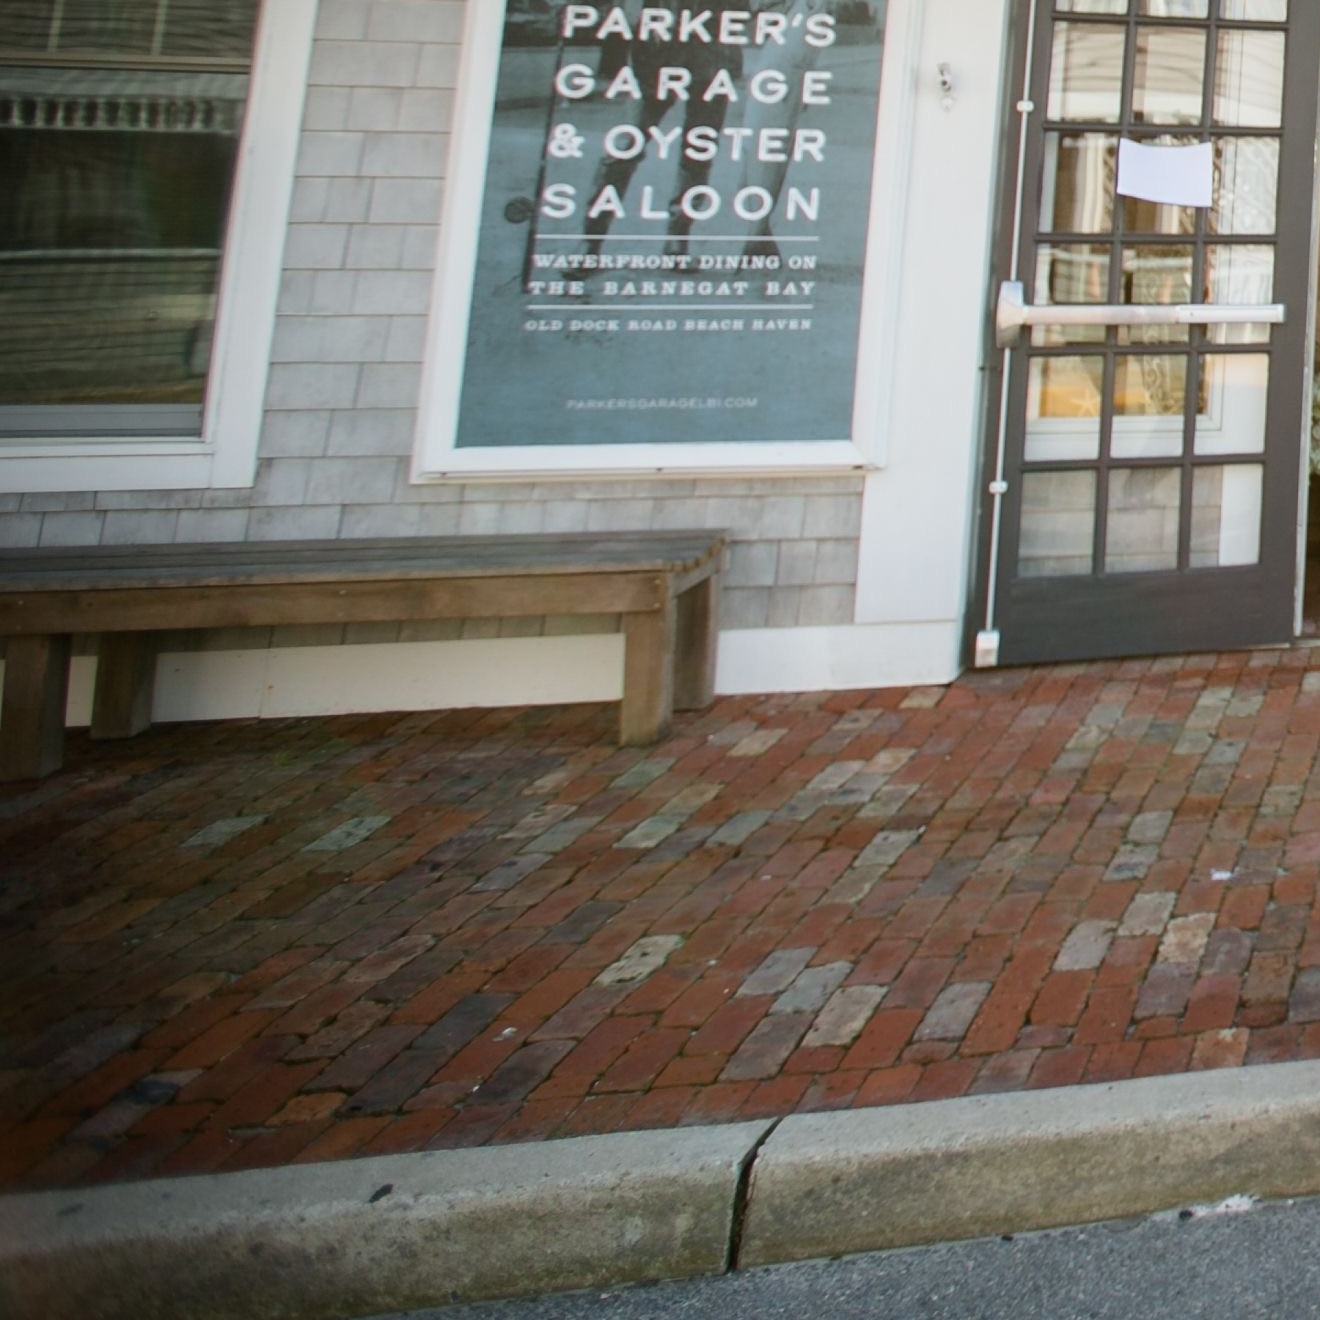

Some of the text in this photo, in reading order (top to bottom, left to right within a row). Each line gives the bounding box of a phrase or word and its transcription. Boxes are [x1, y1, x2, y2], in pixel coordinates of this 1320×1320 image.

[562, 4, 837, 48] PARKER'S
[554, 63, 834, 105] GARAGE
[548, 123, 827, 163] & OYSTER
[541, 183, 821, 222] SALOON
[532, 254, 818, 270] WATERFRONT DINING ON
[527, 281, 816, 296] THE BARNEGAT BAY
[524, 319, 812, 331] OLD DOCK ROAD BEACH HAVEN
